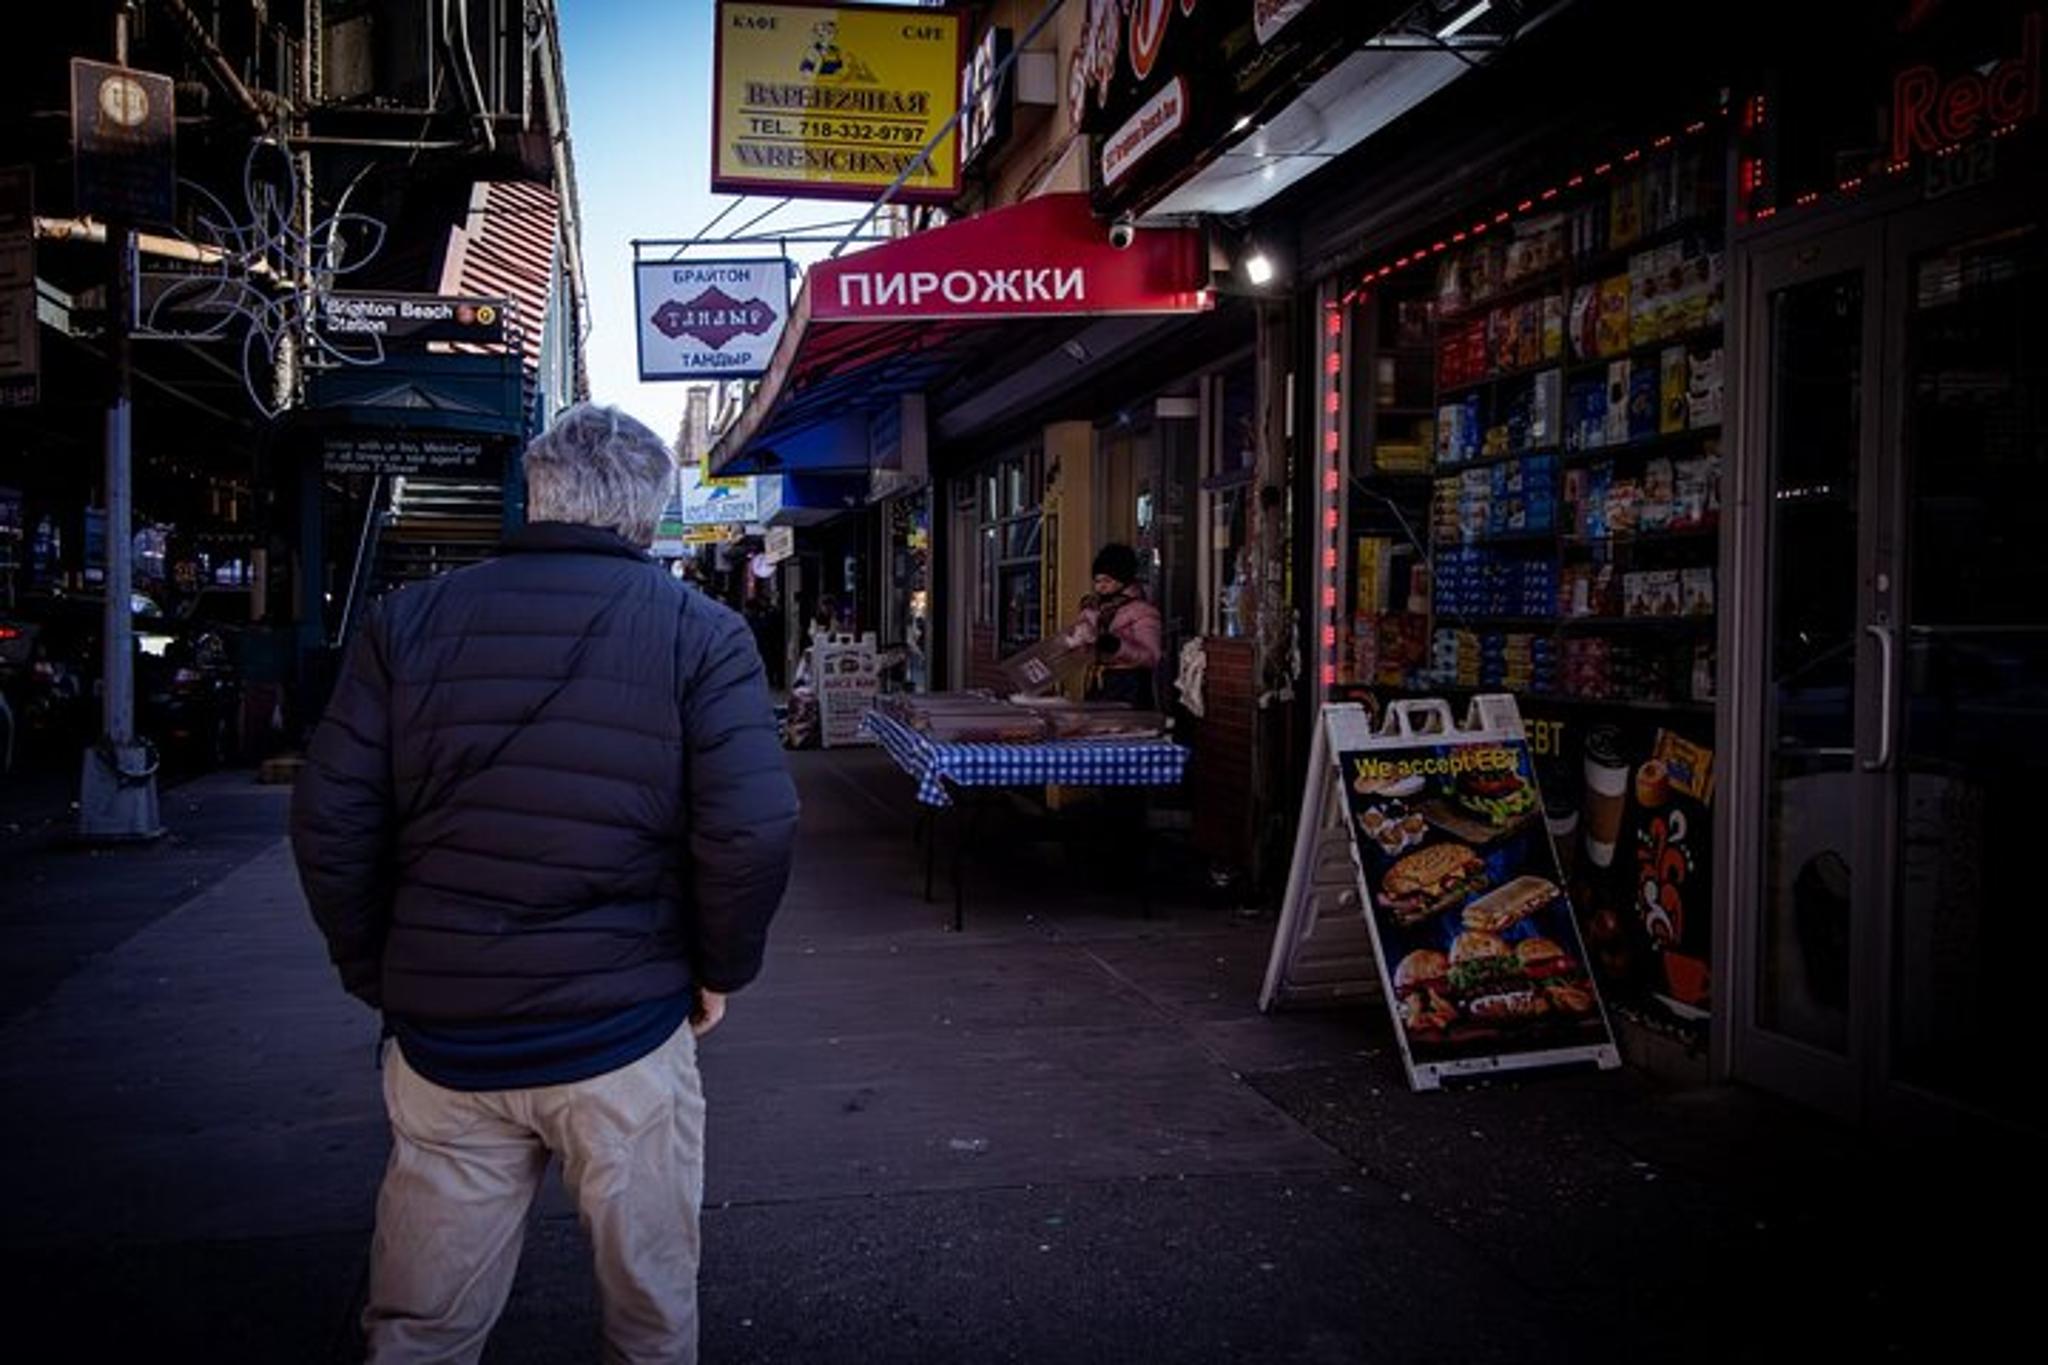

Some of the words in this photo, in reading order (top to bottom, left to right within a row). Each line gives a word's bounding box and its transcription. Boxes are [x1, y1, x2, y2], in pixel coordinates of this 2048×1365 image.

[733, 16, 776, 30] КАФЕ
[902, 25, 944, 41] CAFE
[1893, 10, 2041, 160] Red
[751, 119, 792, 136] TEL.
[799, 121, 925, 143] 718-332-9797
[838, 267, 1086, 306] ПИРОЖКИ
[326, 300, 396, 317] Brighton
[401, 302, 454, 319] Beach
[326, 316, 388, 333] Station
[1352, 755, 1396, 779] We
[1397, 751, 1473, 778] accept
